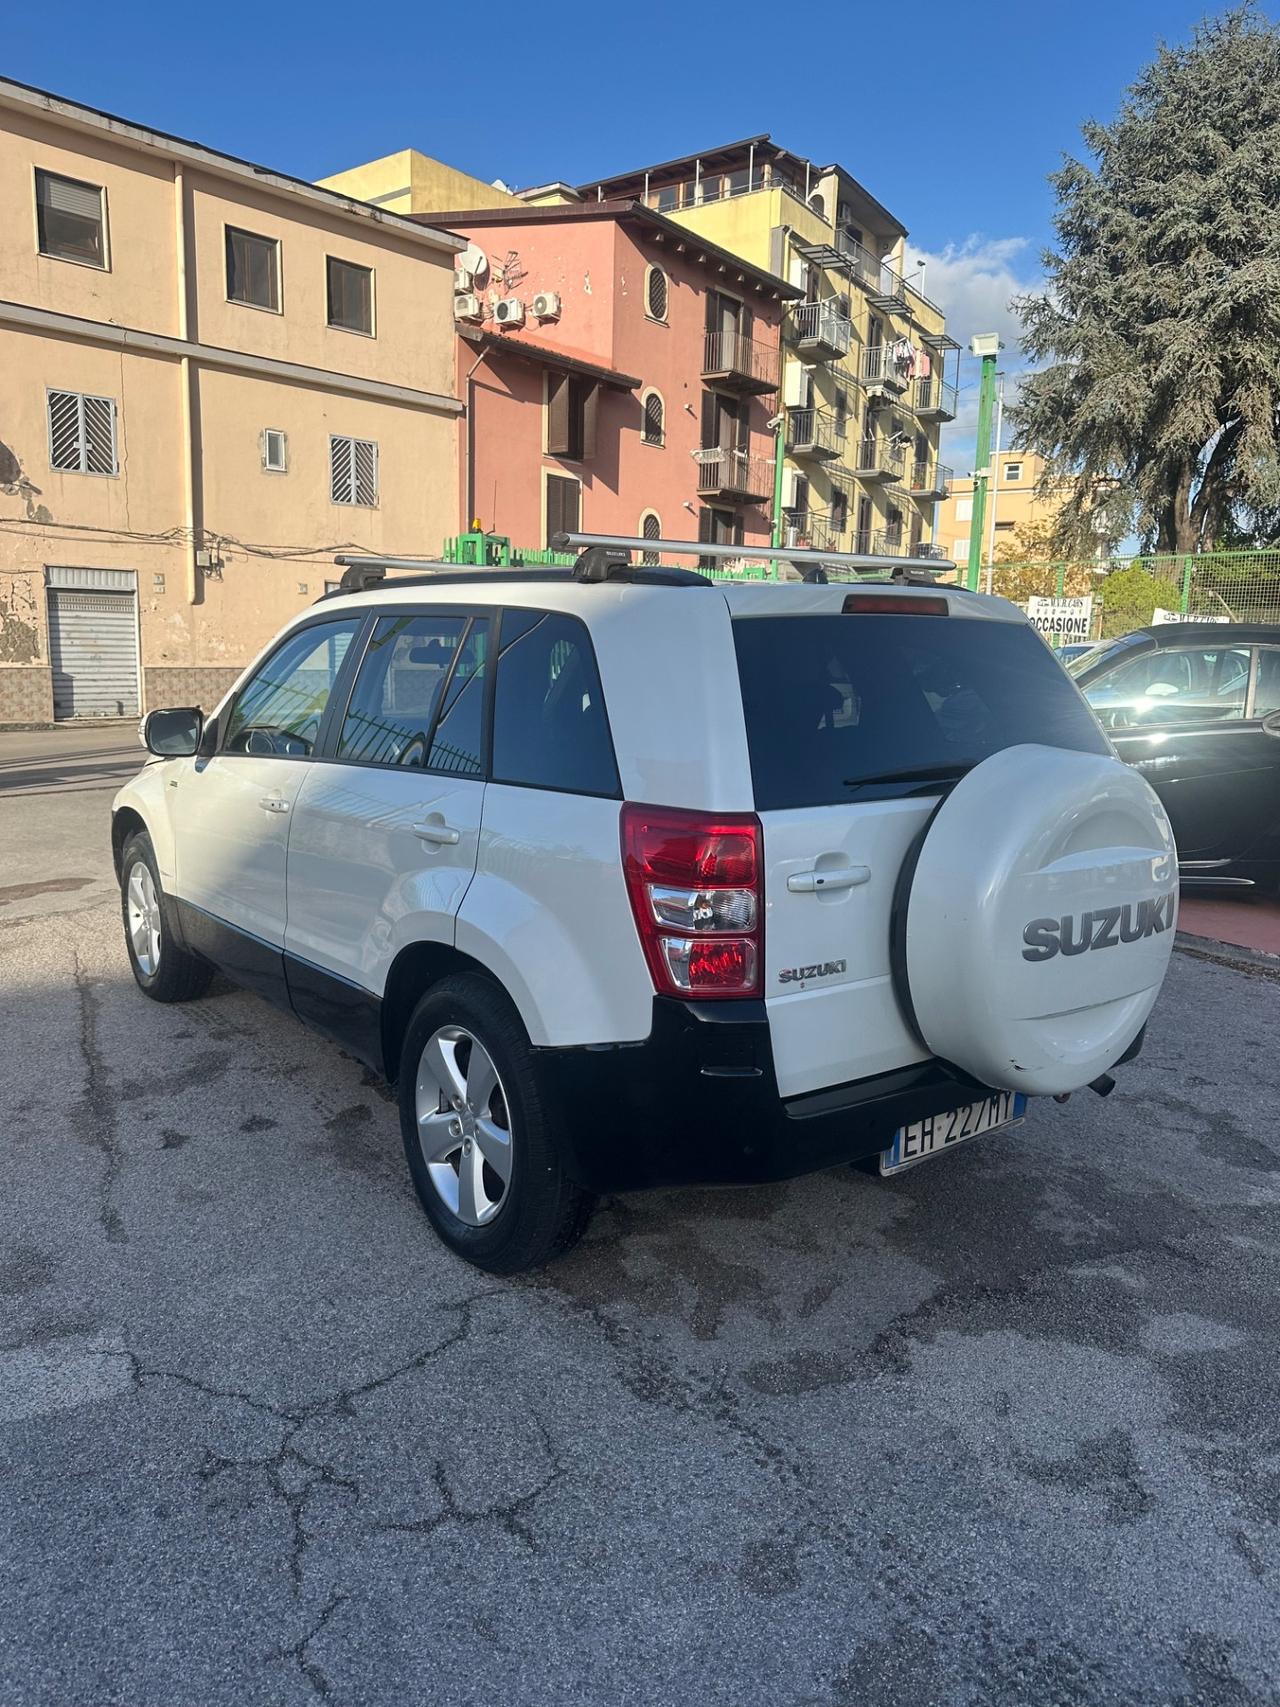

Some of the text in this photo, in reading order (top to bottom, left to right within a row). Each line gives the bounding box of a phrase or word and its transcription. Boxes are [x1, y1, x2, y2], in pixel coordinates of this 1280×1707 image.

[1030, 617, 1088, 634] OCCASIONE
[1022, 892, 1175, 962] SUZUKI
[778, 959, 847, 984] SUZUKI
